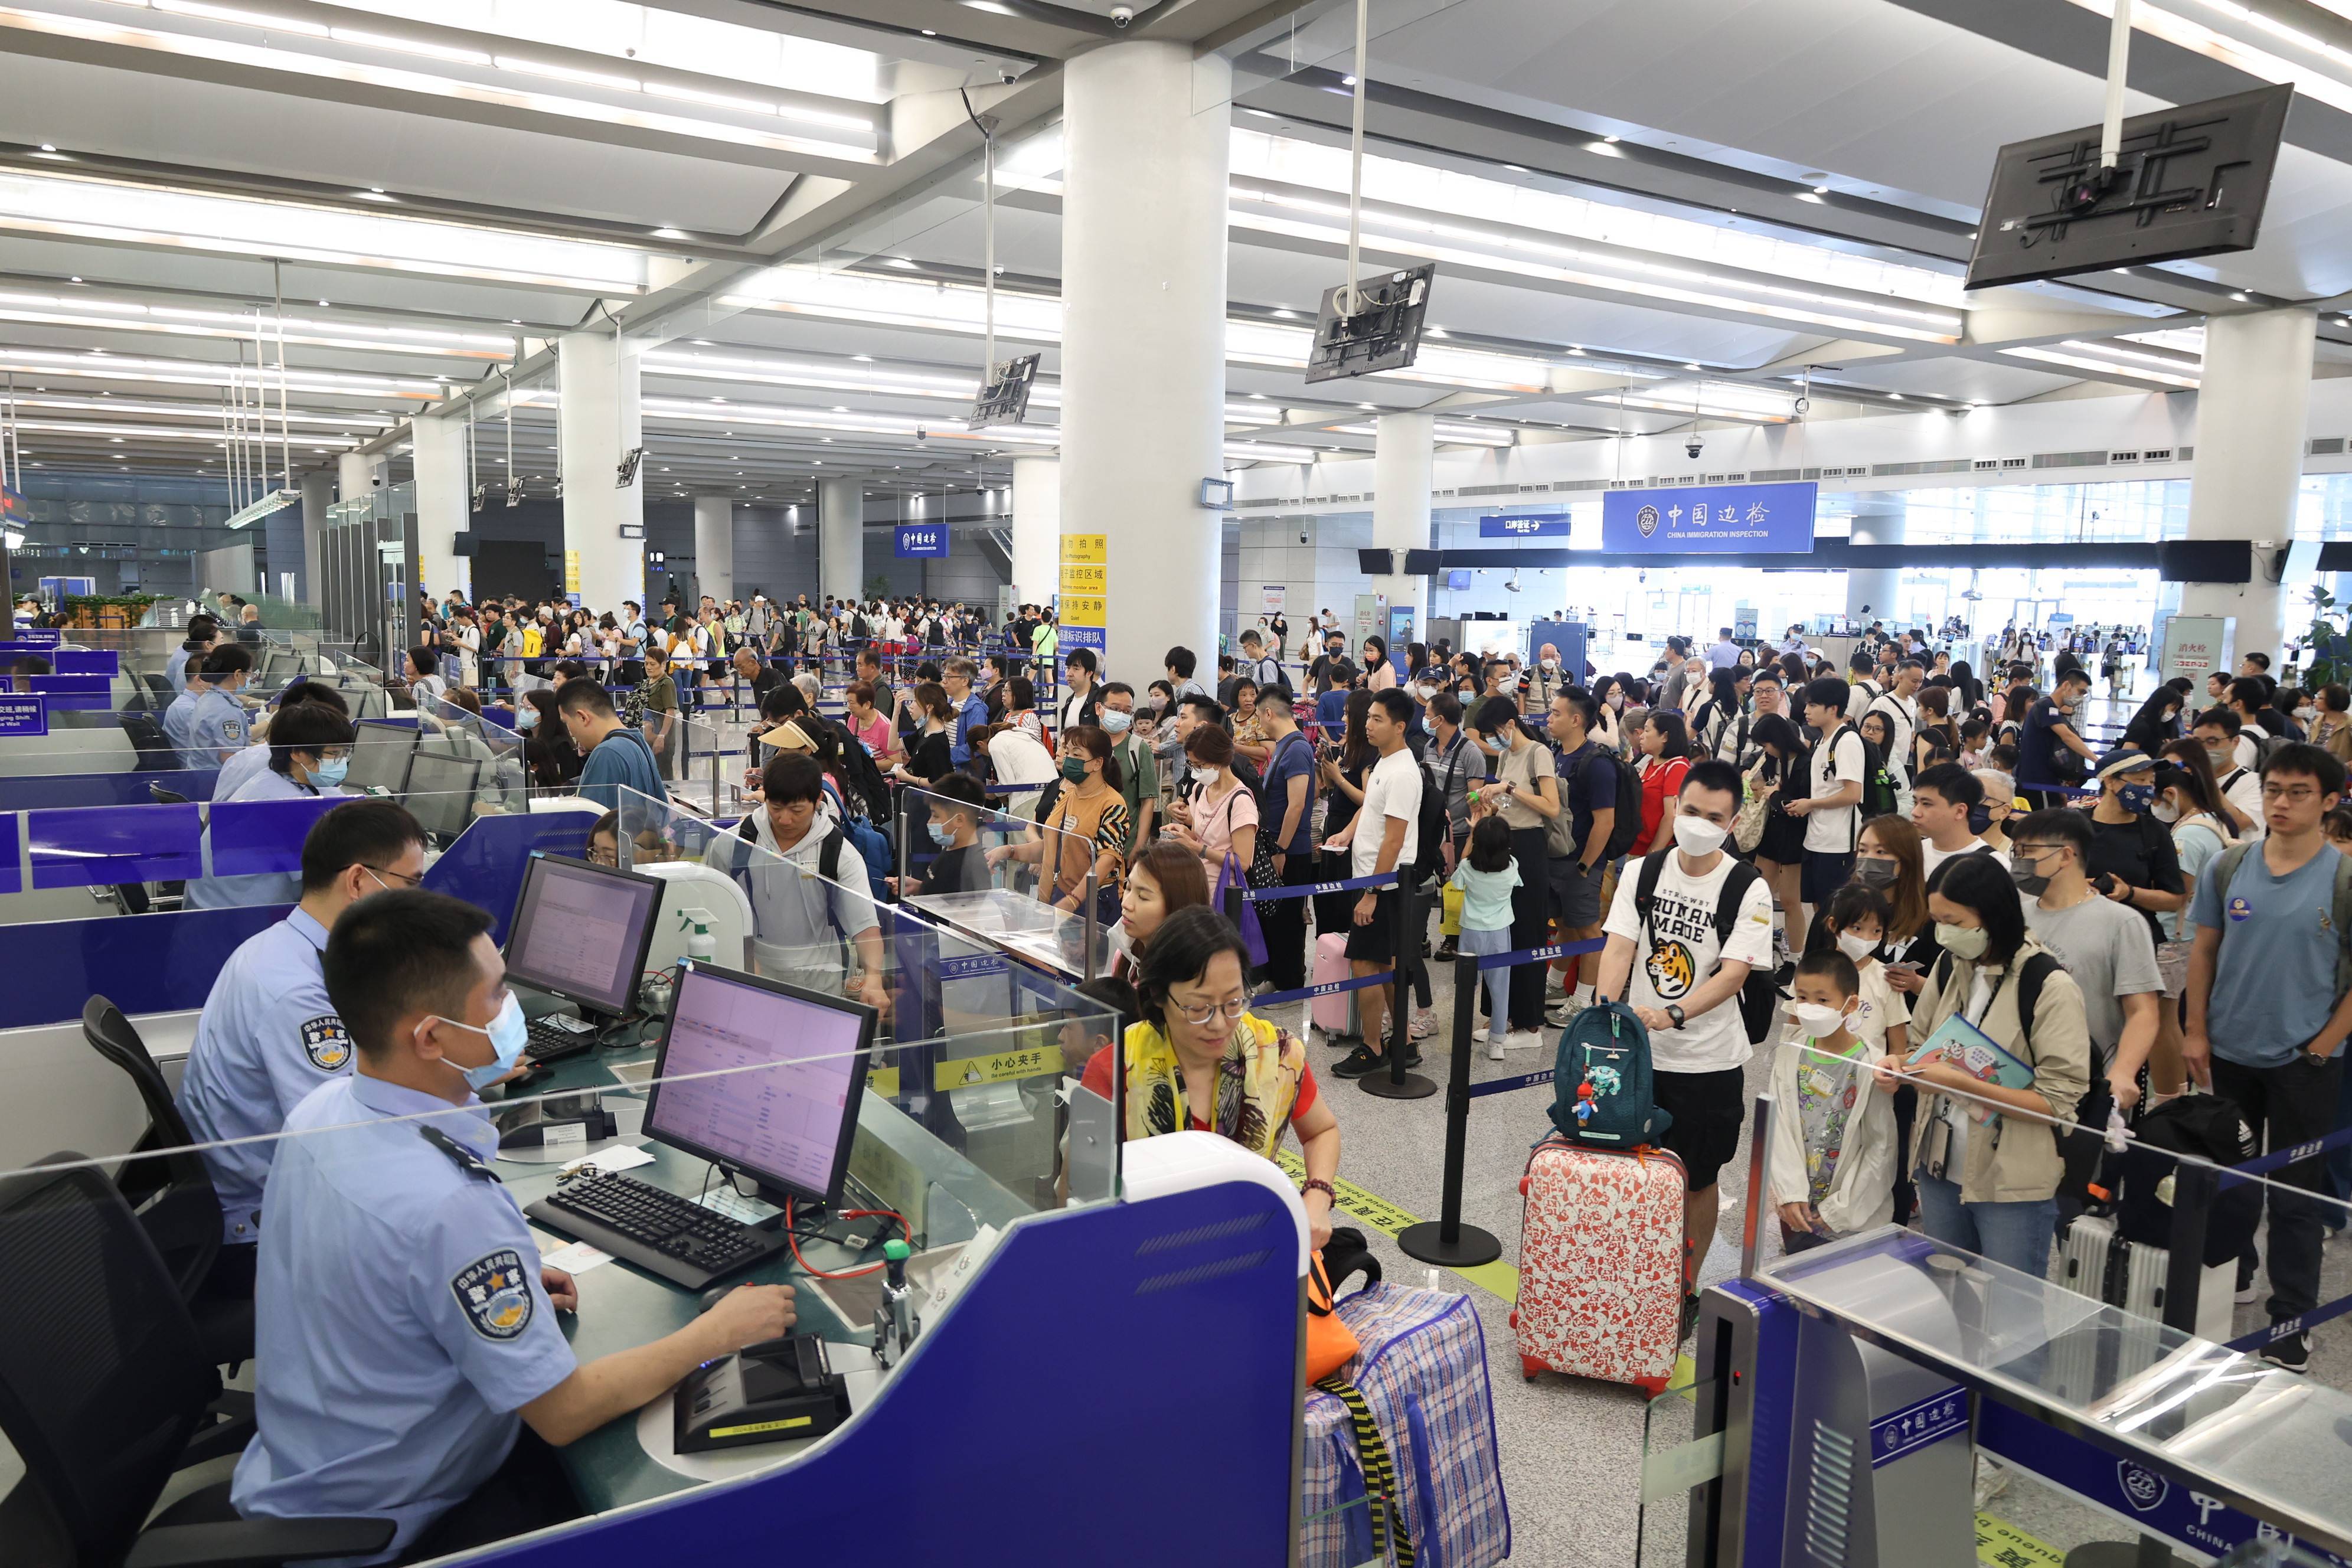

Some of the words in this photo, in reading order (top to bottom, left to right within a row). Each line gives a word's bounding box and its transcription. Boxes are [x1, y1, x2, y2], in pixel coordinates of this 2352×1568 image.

[1668, 501, 1770, 528] 中国边检
[1505, 520, 1530, 529] 口岸签证
[911, 532, 937, 545] 中国边检
[2178, 643, 2207, 652] 消火栓
[1315, 881, 1342, 891] 中国边检
[1654, 914, 1705, 943] MADE
[1531, 945, 1562, 957] 中国边检
[961, 956, 998, 970] 中国边检
[1314, 982, 1340, 993] 中国边检
[992, 1052, 1041, 1070] 小心夹手
[1276, 1151, 1289, 1159] lin
[1366, 1198, 1395, 1214] queue
[1396, 1213, 1415, 1224] ase
[1902, 1400, 1956, 1436] 中国边检
[2186, 1524, 2233, 1552] CHINA
[1997, 1529, 2062, 1563] queue
